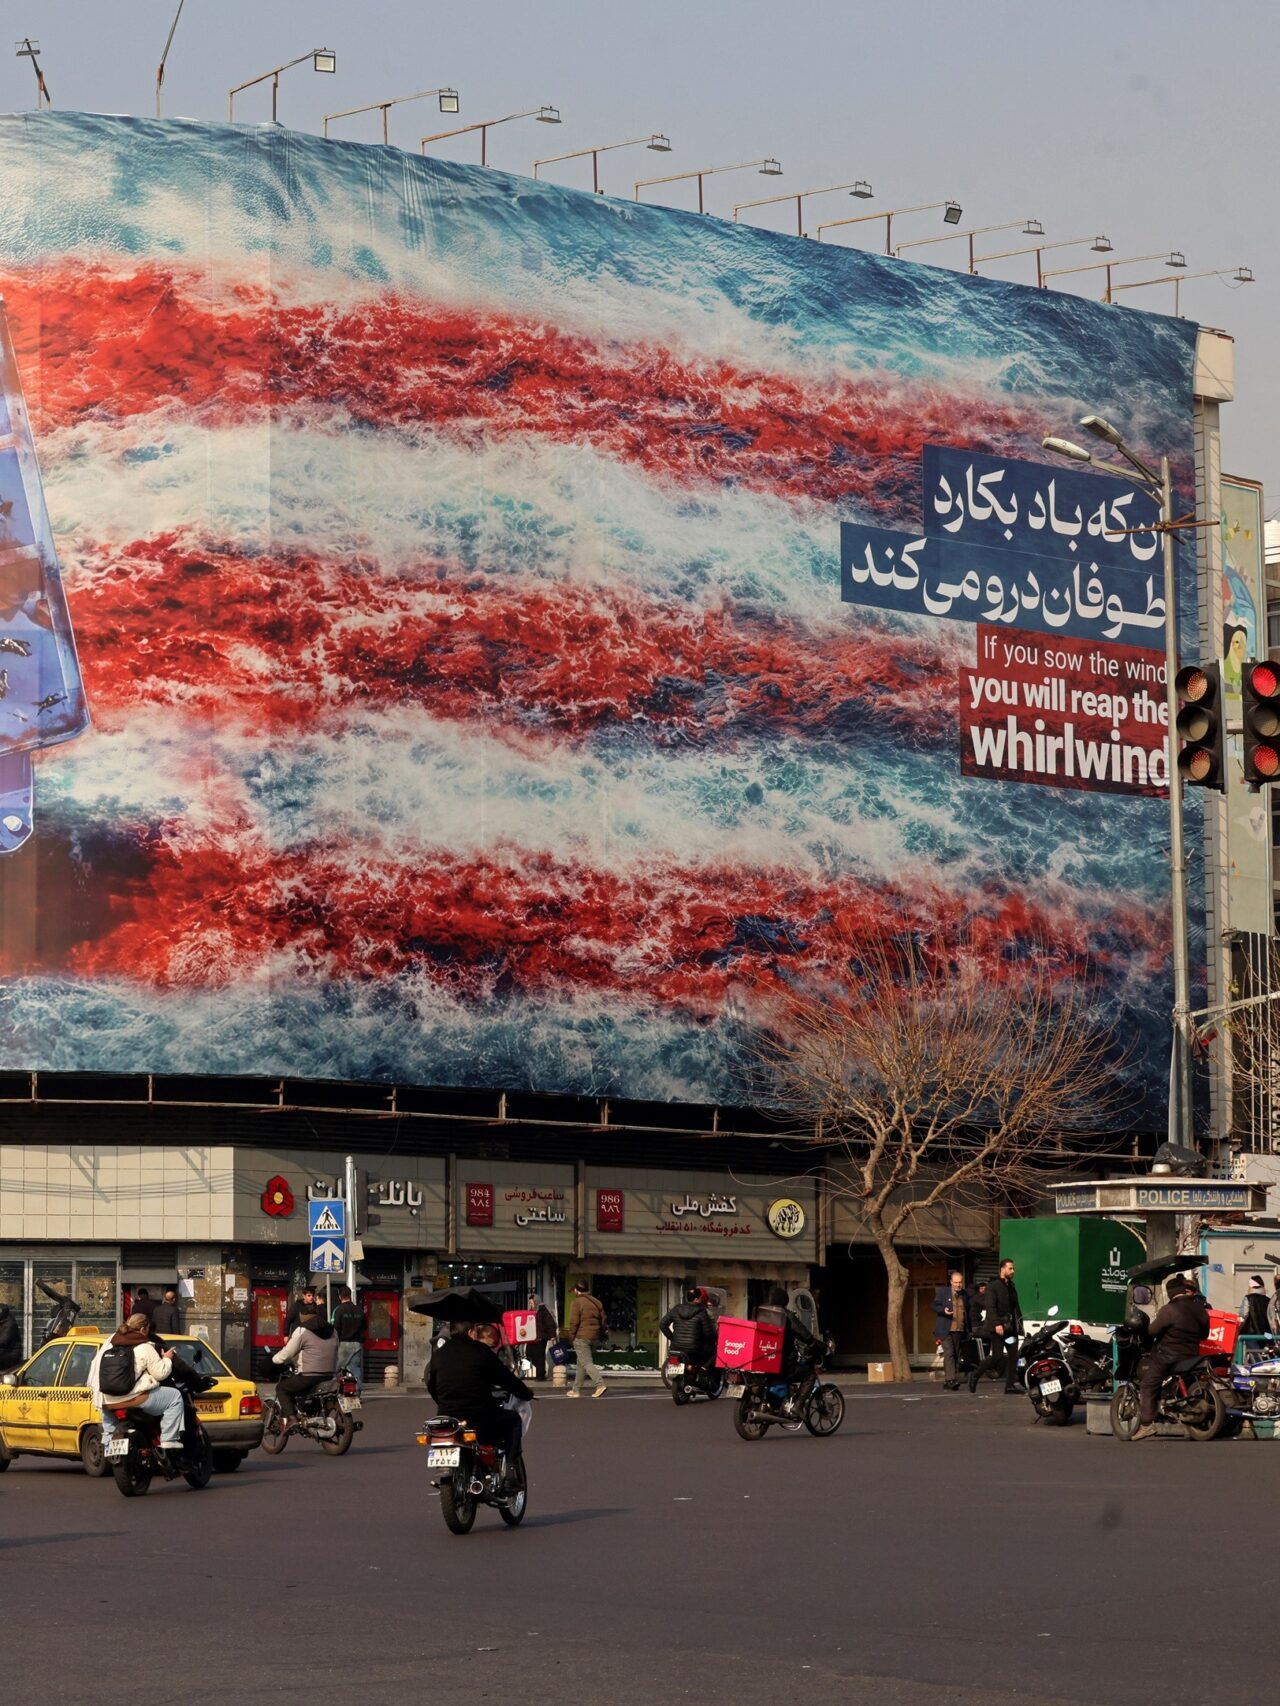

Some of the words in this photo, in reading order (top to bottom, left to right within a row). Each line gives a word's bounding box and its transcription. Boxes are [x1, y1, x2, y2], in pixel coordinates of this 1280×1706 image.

[933, 464, 1018, 540] بکارد
[1027, 479, 1082, 551] باد
[1086, 491, 1135, 542] که
[984, 635, 997, 660] If
[1003, 642, 1038, 670] you
[1044, 649, 1083, 672] sow
[1089, 651, 1119, 677] the
[1124, 657, 1168, 684] wind
[968, 674, 1018, 709] you
[1022, 677, 1067, 712] will
[1071, 689, 1128, 726] reap
[1132, 690, 1170, 726] the
[970, 715, 1171, 788] whirlwind
[378, 1180, 423, 1215] بانک
[470, 1188, 491, 1198] 984
[600, 1195, 620, 1204] 986
[672, 1194, 699, 1215] ملی
[699, 1193, 737, 1216] کفش
[1138, 1190, 1190, 1205] POLICE
[516, 1206, 566, 1226] ساعتی
[655, 1221, 682, 1235] انقلاب
[724, 1347, 739, 1355] Food
